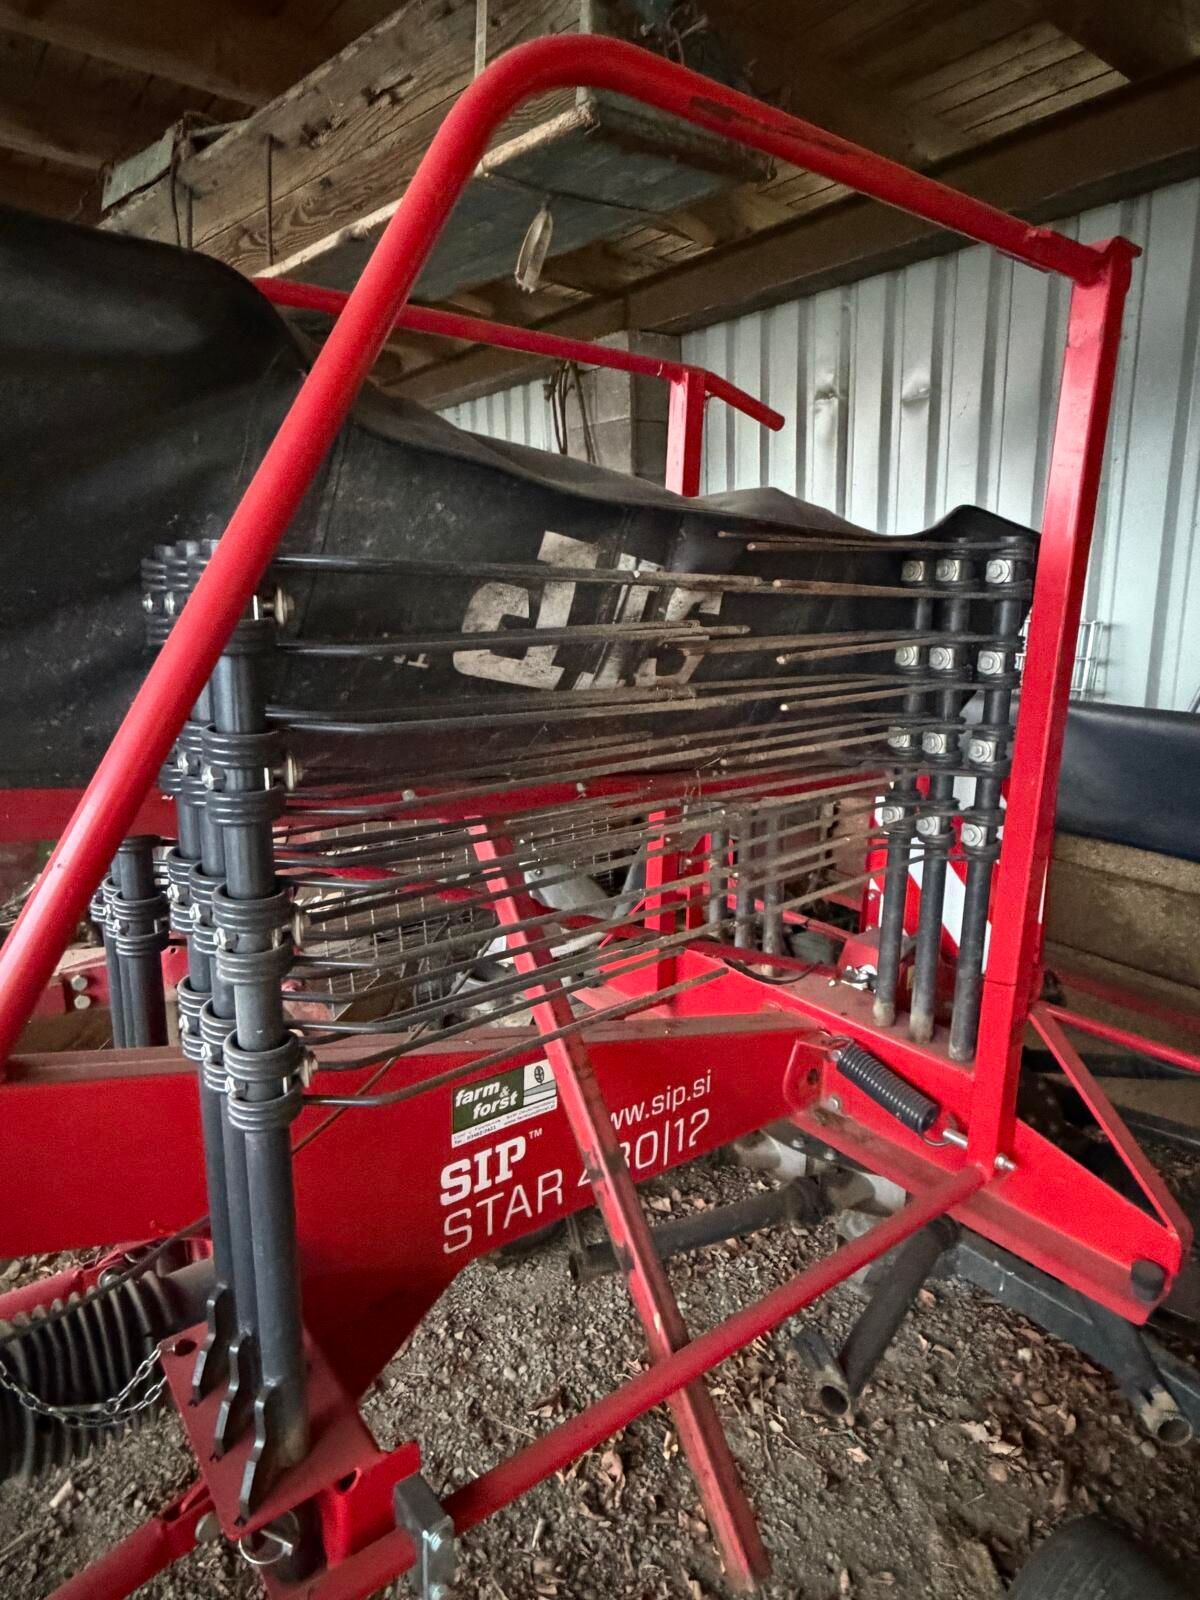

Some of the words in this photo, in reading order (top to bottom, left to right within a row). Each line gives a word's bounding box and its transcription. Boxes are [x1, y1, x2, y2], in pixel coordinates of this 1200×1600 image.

[454, 1080, 501, 1108] farm
[499, 1085, 511, 1099] &
[472, 1090, 518, 1120] forst
[440, 1135, 527, 1206] SIP
[442, 1168, 564, 1254] STAR
